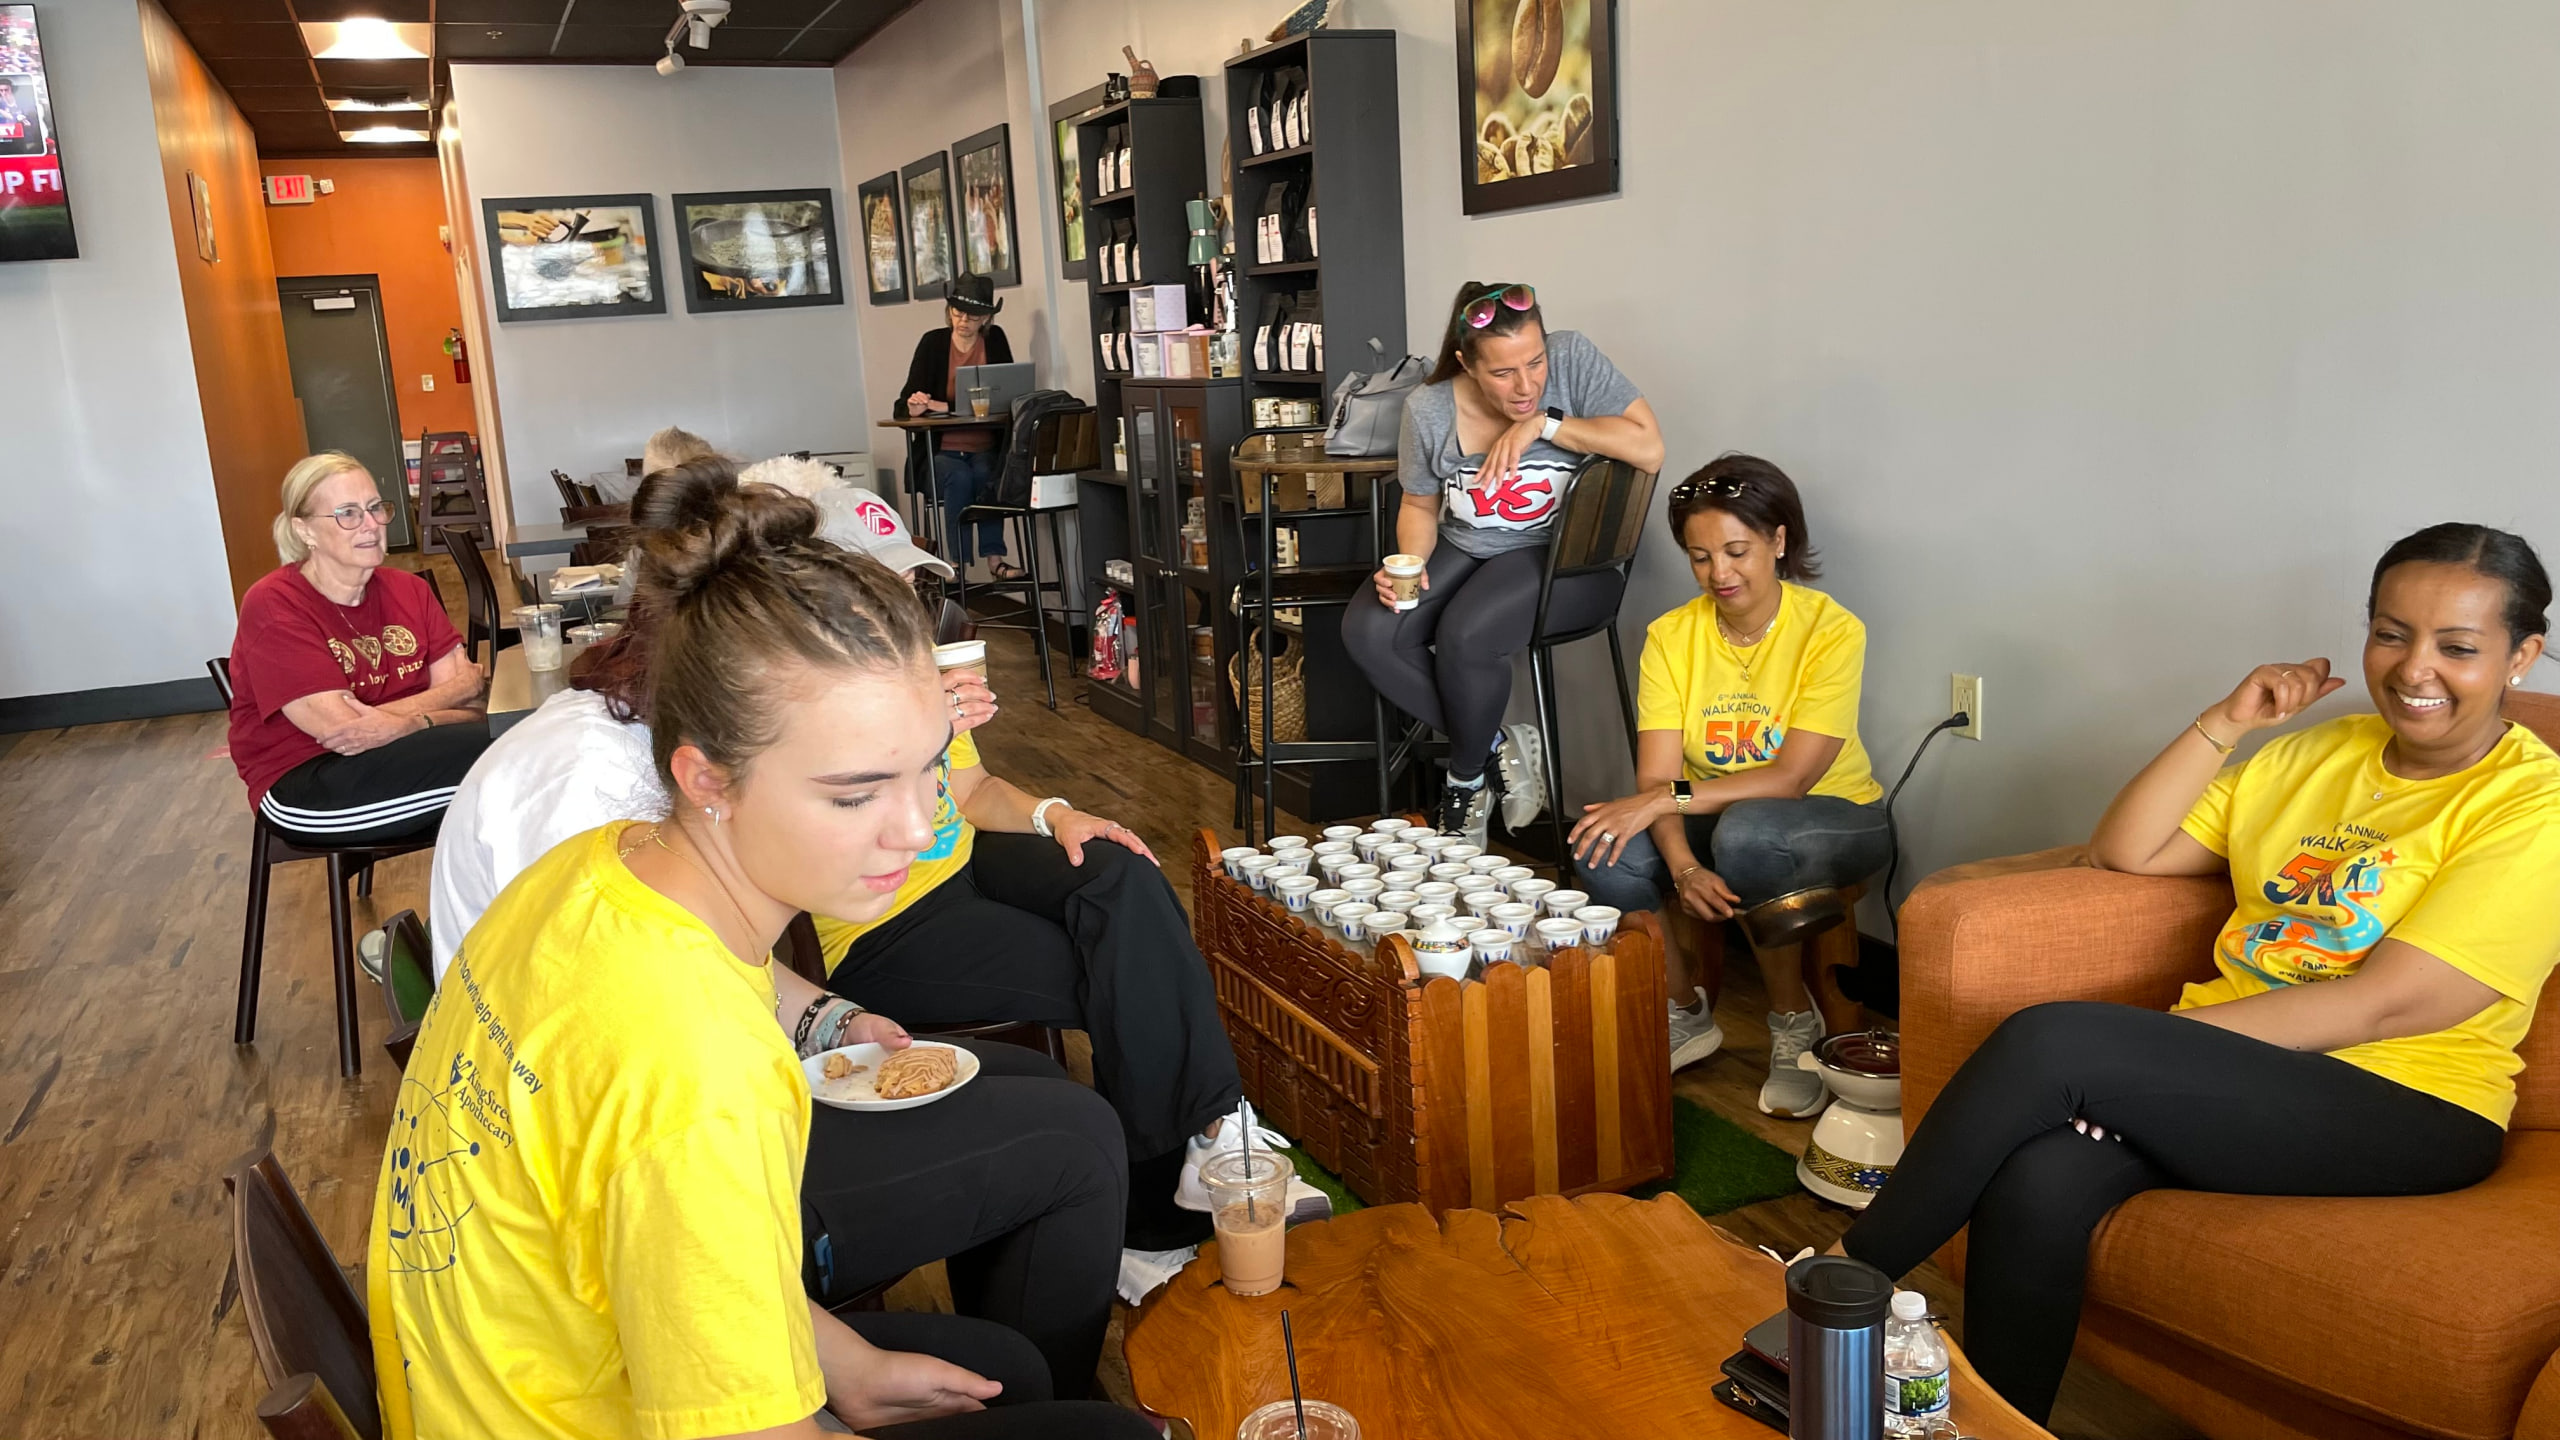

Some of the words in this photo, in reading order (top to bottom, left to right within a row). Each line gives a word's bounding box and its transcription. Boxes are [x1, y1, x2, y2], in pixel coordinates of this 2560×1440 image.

[274, 176, 306, 200] EXIT
[1466, 475, 1555, 522] KC
[1702, 702, 1771, 718] WALKATHON
[1730, 692, 1758, 701] ANNUAL
[1705, 720, 1768, 766] 5K
[2344, 823, 2389, 842] ANNUAL
[488, 1016, 509, 1048] light
[503, 1039, 515, 1064] the
[513, 1060, 543, 1095] way
[454, 1086, 514, 1149] Apothecary
